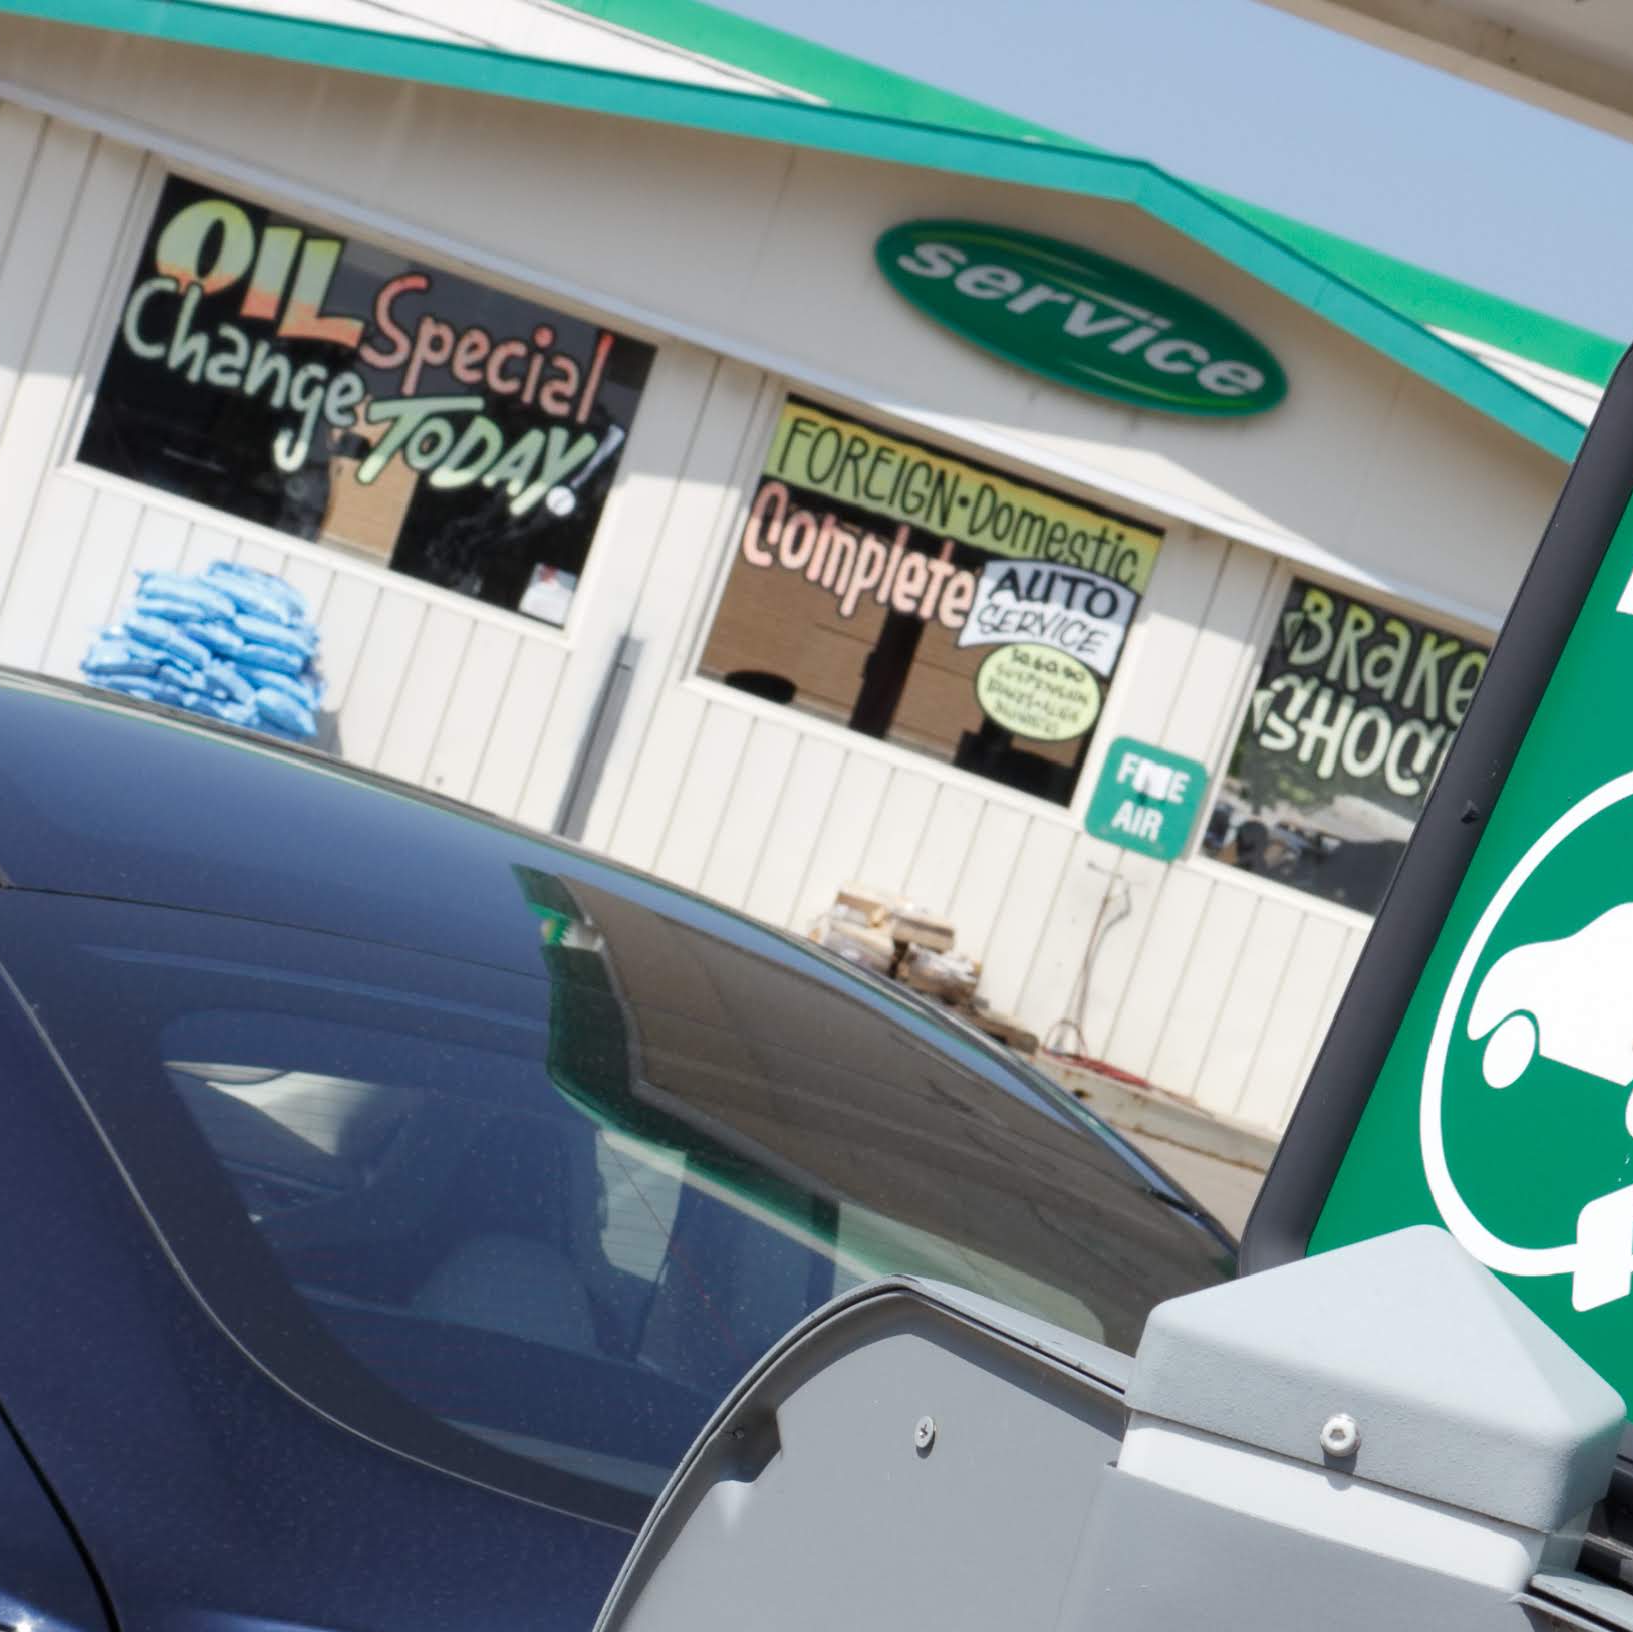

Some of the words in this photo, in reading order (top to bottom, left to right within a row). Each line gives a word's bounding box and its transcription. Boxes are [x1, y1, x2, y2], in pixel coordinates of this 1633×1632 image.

[155, 199, 364, 348] OIL
[360, 274, 615, 424] Special
[897, 242, 1264, 396] service
[122, 277, 364, 471] Change
[977, 603, 1109, 655] SERVICE
[988, 566, 1118, 620] AUTO
[1253, 672, 1455, 796] SHOC
[1110, 799, 1164, 842] AIR
